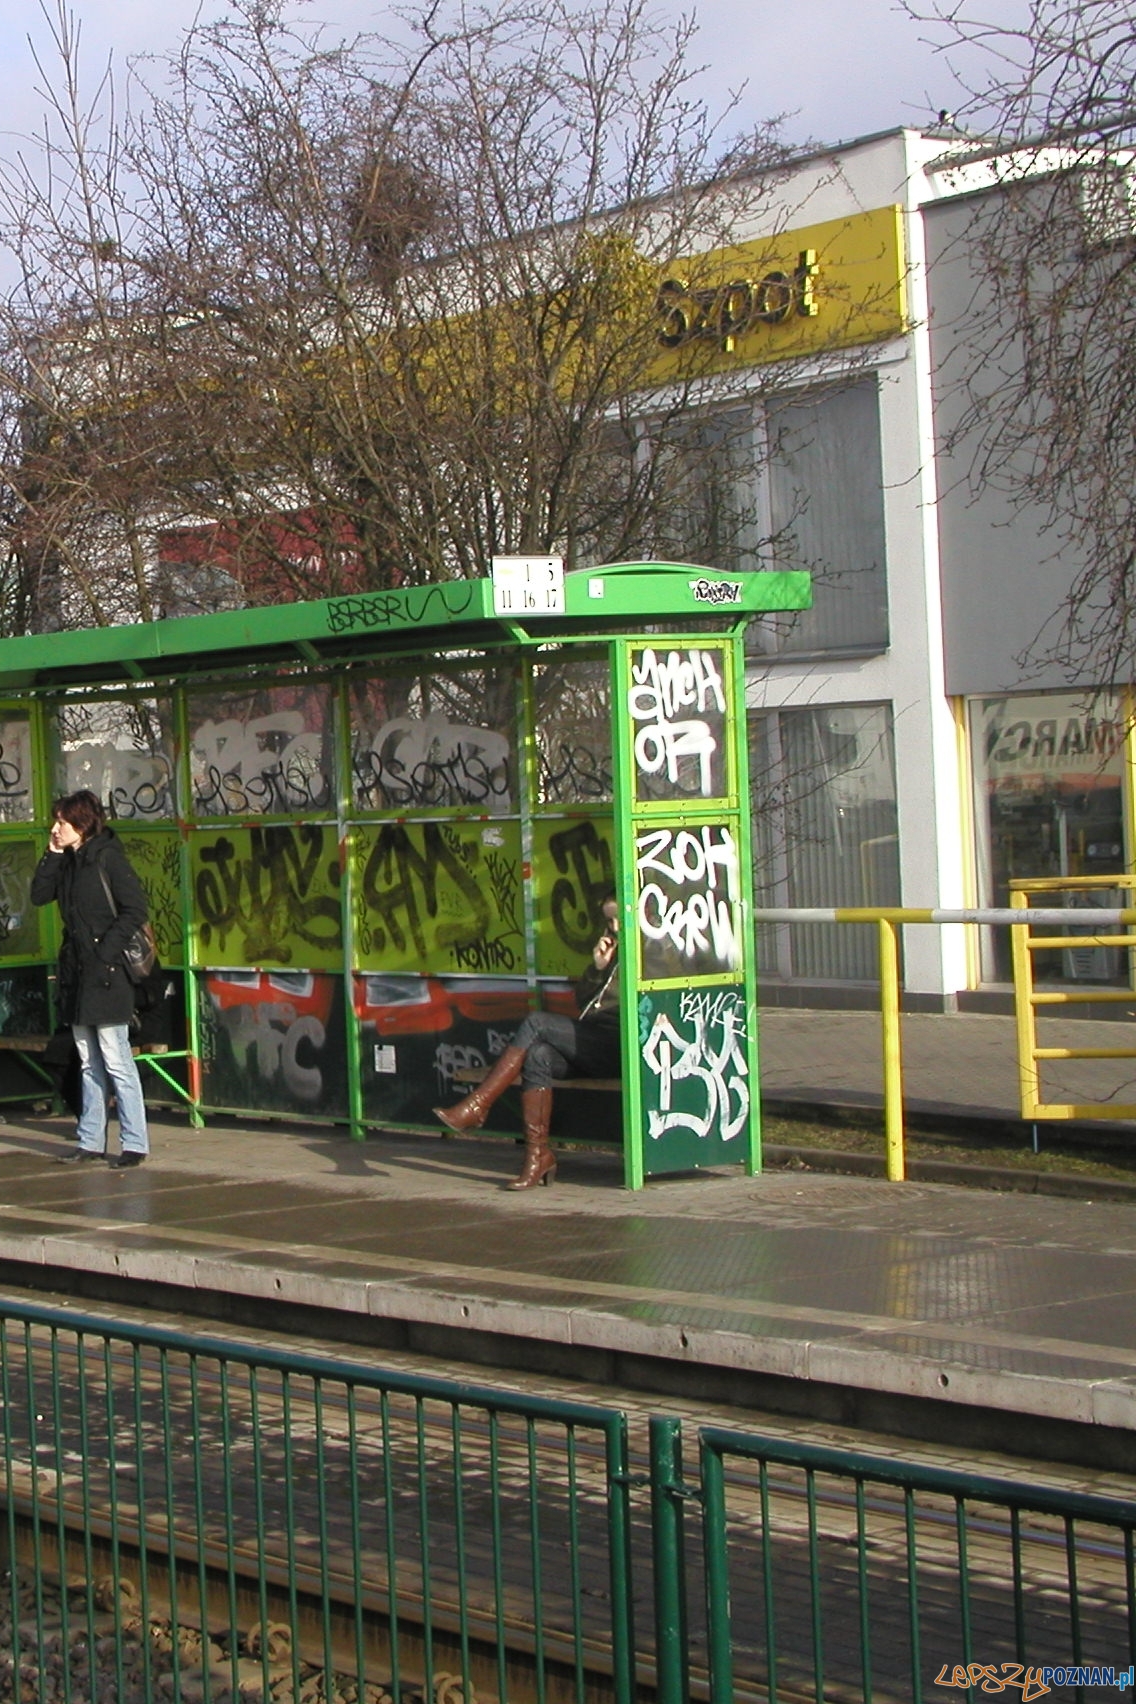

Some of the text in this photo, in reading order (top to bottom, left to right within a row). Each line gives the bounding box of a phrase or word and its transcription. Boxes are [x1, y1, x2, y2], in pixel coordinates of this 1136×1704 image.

[657, 248, 819, 352] Szpot
[502, 588, 557, 608] 11 16 17
